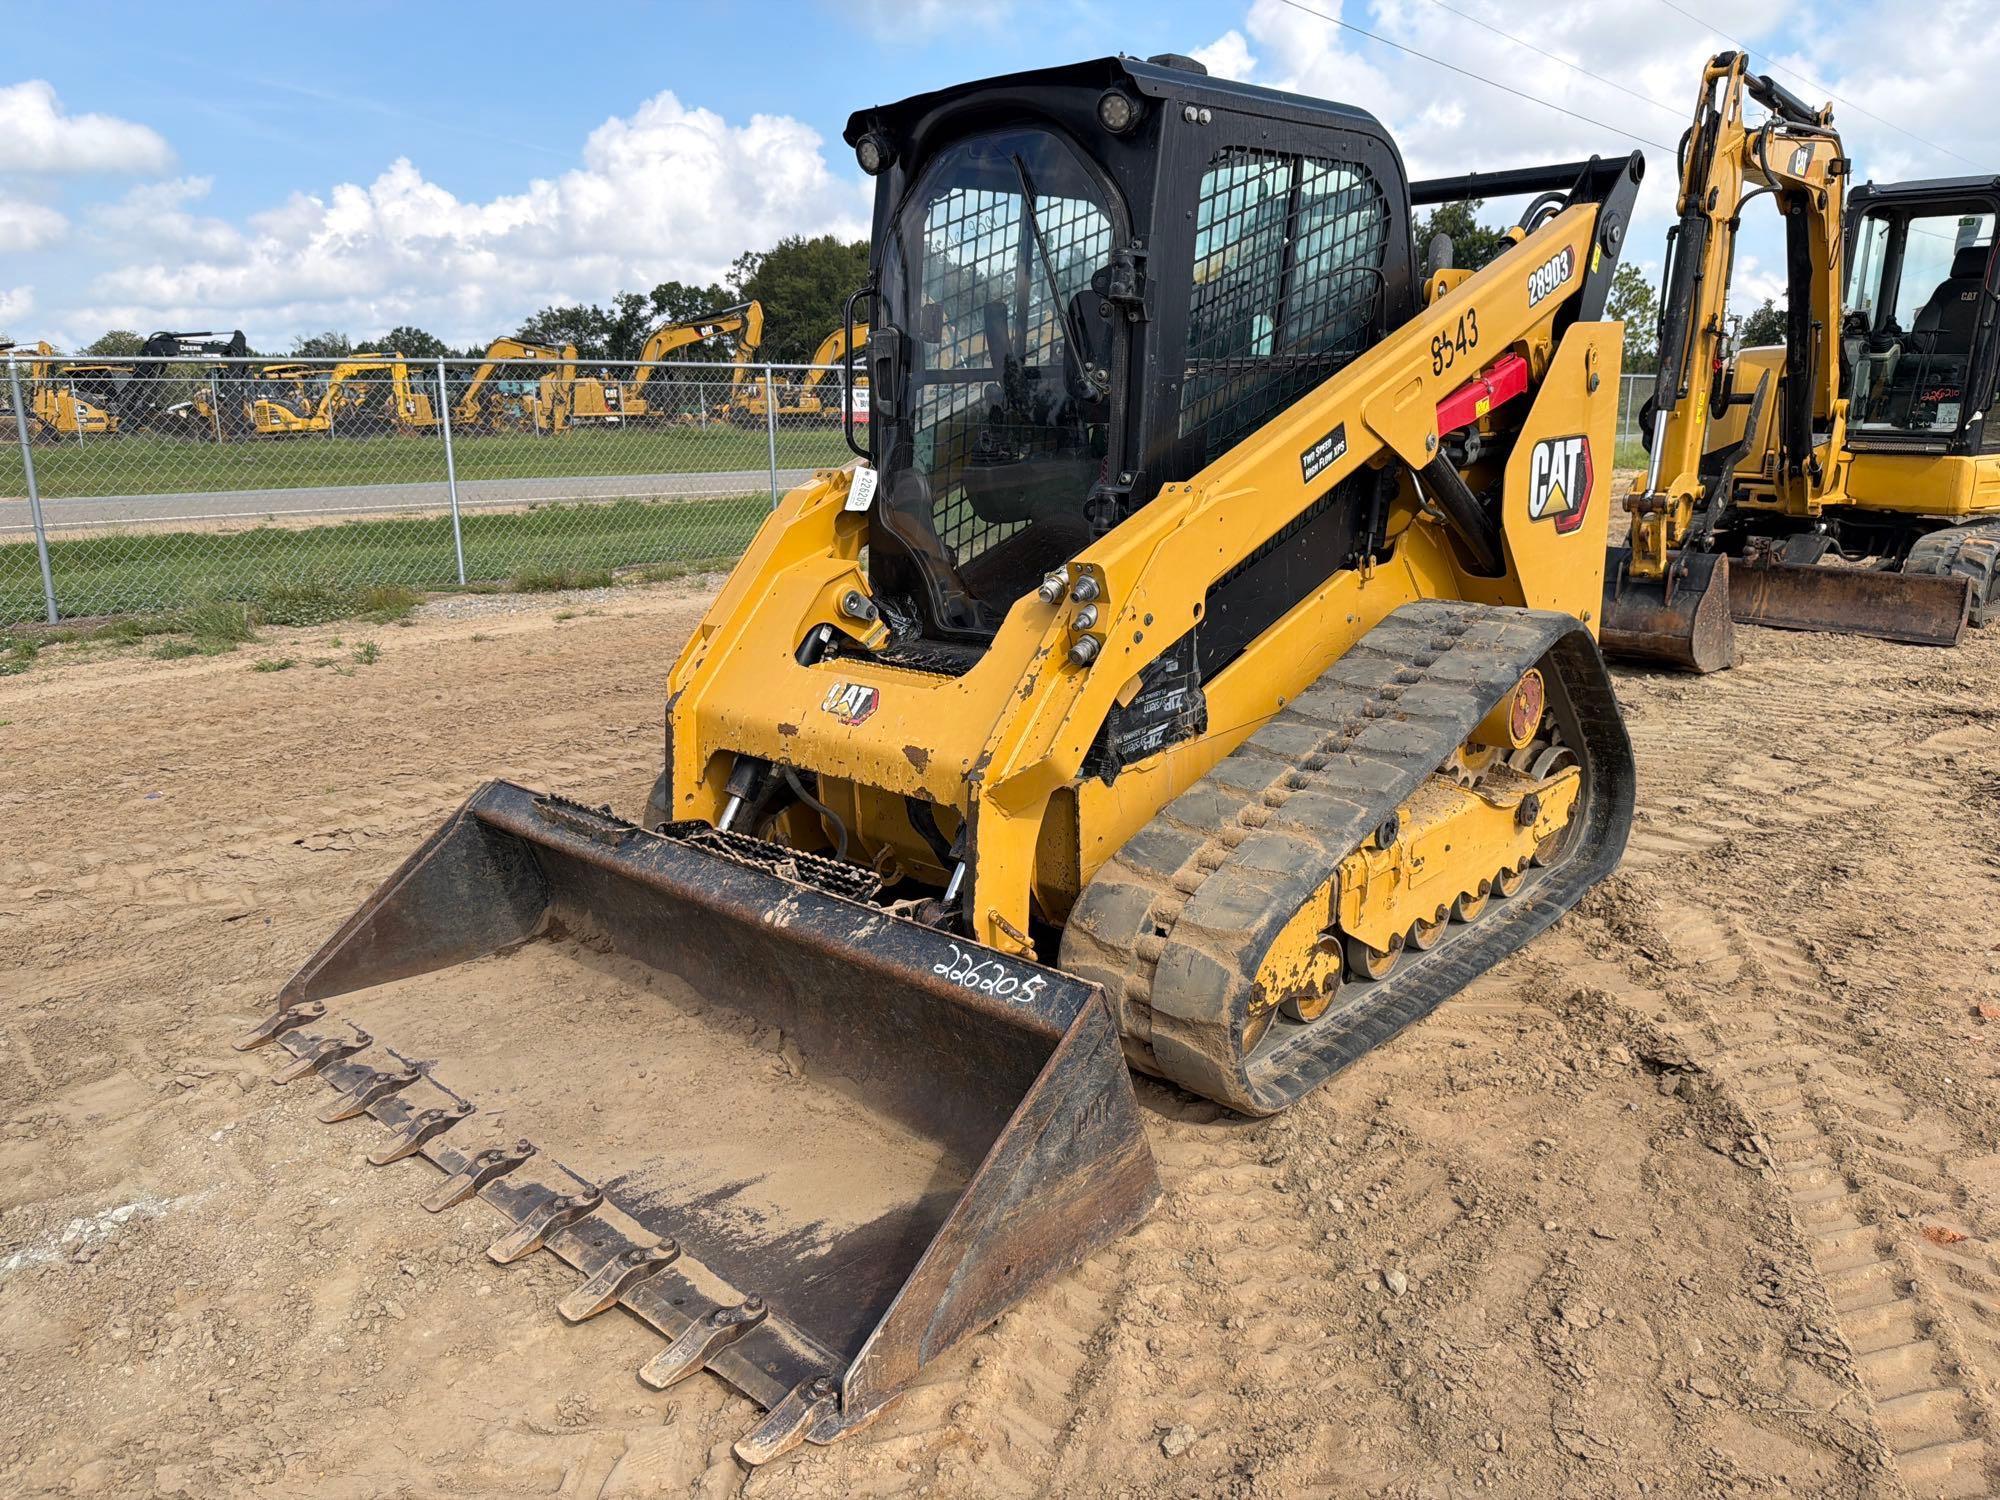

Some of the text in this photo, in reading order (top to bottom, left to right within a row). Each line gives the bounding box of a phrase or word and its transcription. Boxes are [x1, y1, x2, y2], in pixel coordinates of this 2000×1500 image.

[1795, 149, 1808, 176] CAT
[1528, 250, 1569, 307] 289D3
[1961, 292, 1978, 301] CAT
[700, 325, 713, 336] CAT
[605, 389, 618, 398] CAT
[1333, 440, 1345, 458] XPS
[1530, 438, 1582, 518] CAT
[855, 477, 872, 507] 226205
[933, 944, 1048, 1002] 226205
